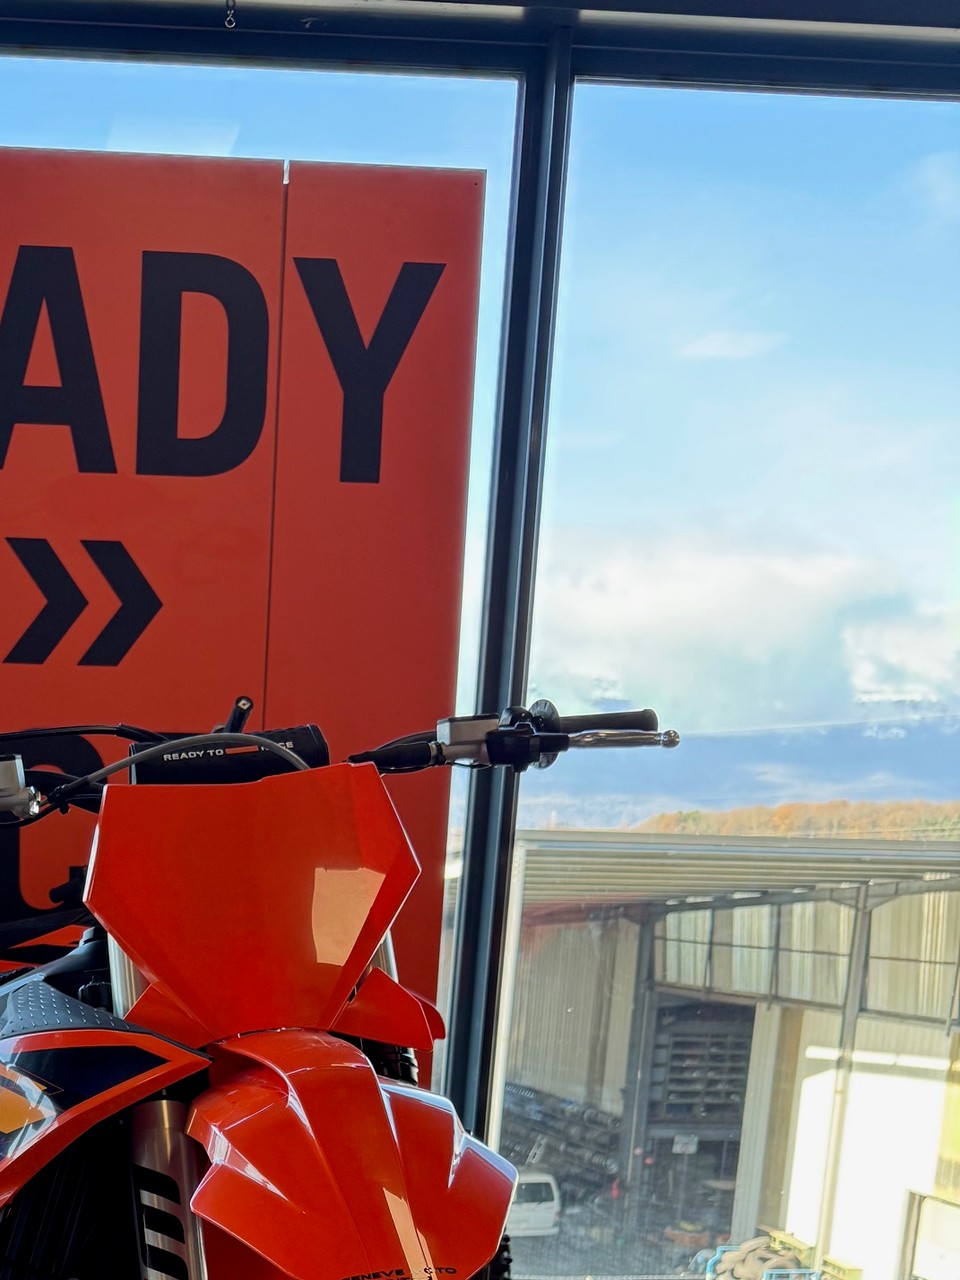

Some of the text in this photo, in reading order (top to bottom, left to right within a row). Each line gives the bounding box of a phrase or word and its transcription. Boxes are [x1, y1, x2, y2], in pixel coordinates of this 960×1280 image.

[163, 741, 294, 761] READY TO CE
[411, 1266, 457, 1279] OTO
